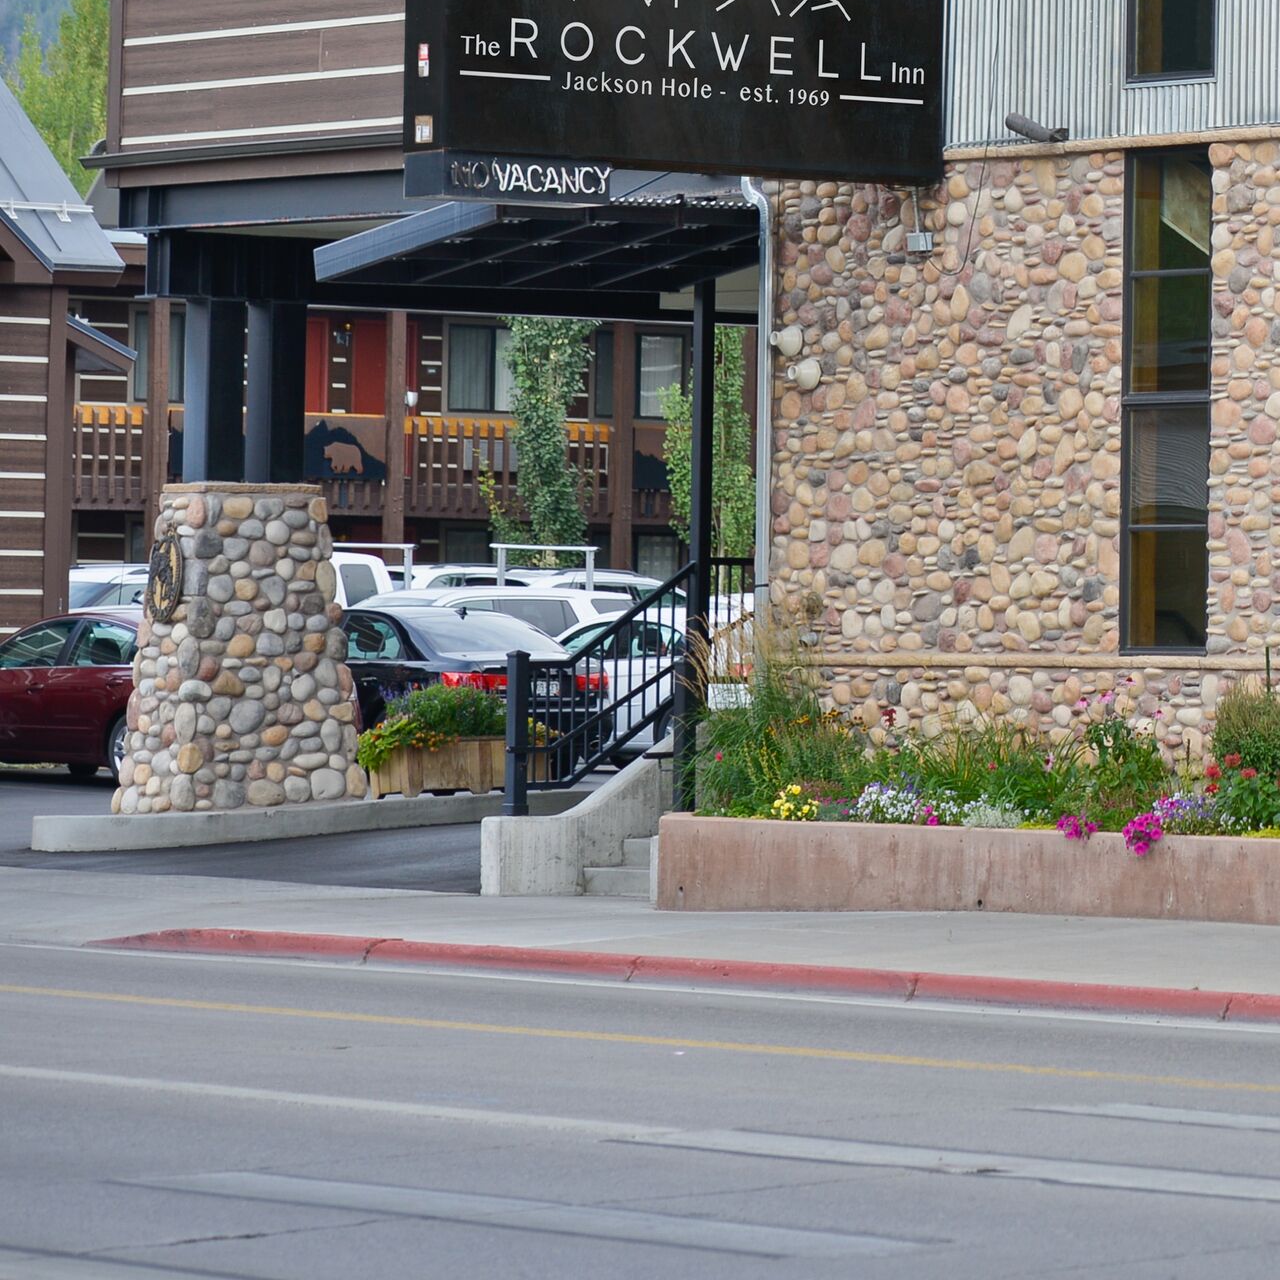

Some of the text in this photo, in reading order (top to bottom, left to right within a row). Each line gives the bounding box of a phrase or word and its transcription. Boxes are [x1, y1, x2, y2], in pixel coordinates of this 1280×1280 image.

[460, 17, 925, 85] The ROCKWELL Inn
[561, 71, 653, 96] Jackson
[661, 76, 712, 99] Hole
[739, 84, 780, 103] est.
[788, 87, 830, 108] 1969
[450, 160, 612, 195] NO VACANCY
